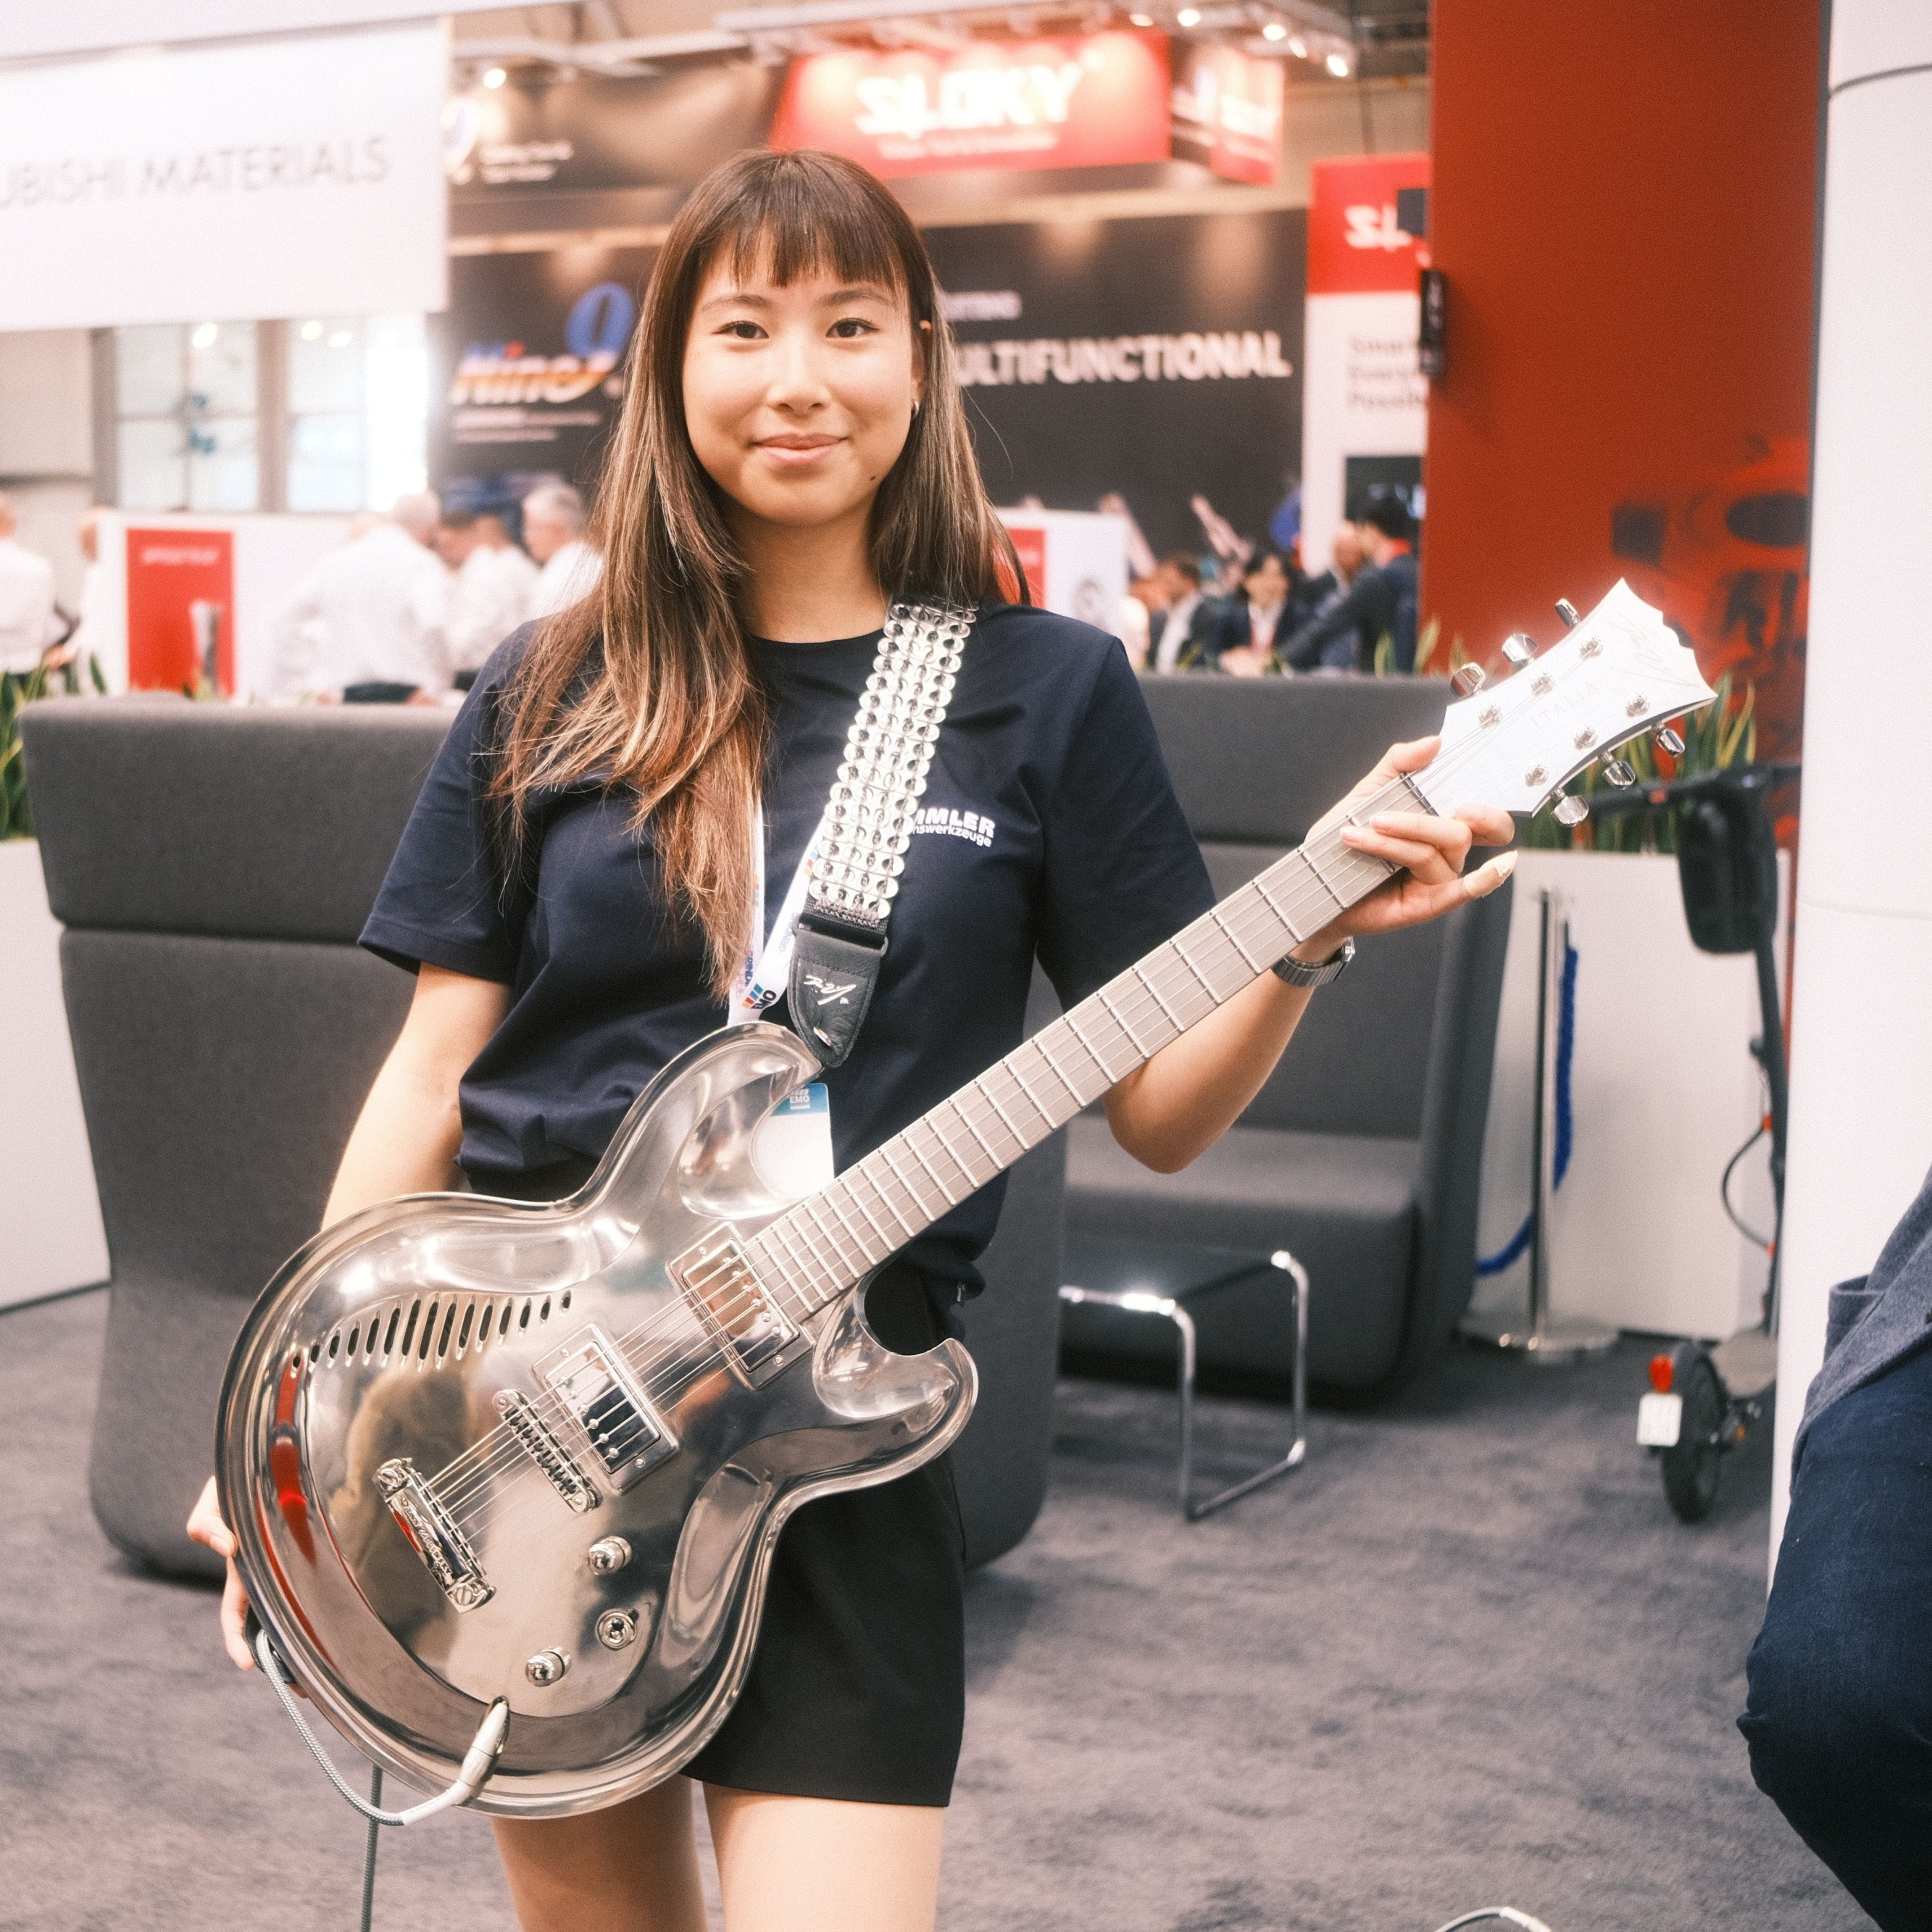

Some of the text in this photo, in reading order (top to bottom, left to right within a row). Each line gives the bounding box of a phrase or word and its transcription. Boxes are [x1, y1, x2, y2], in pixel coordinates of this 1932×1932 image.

[138, 133, 392, 195] MATERIALS
[1530, 682, 1600, 728] ITALIA
[751, 989, 777, 1009] EMO
[789, 1094, 810, 1104] EMO
